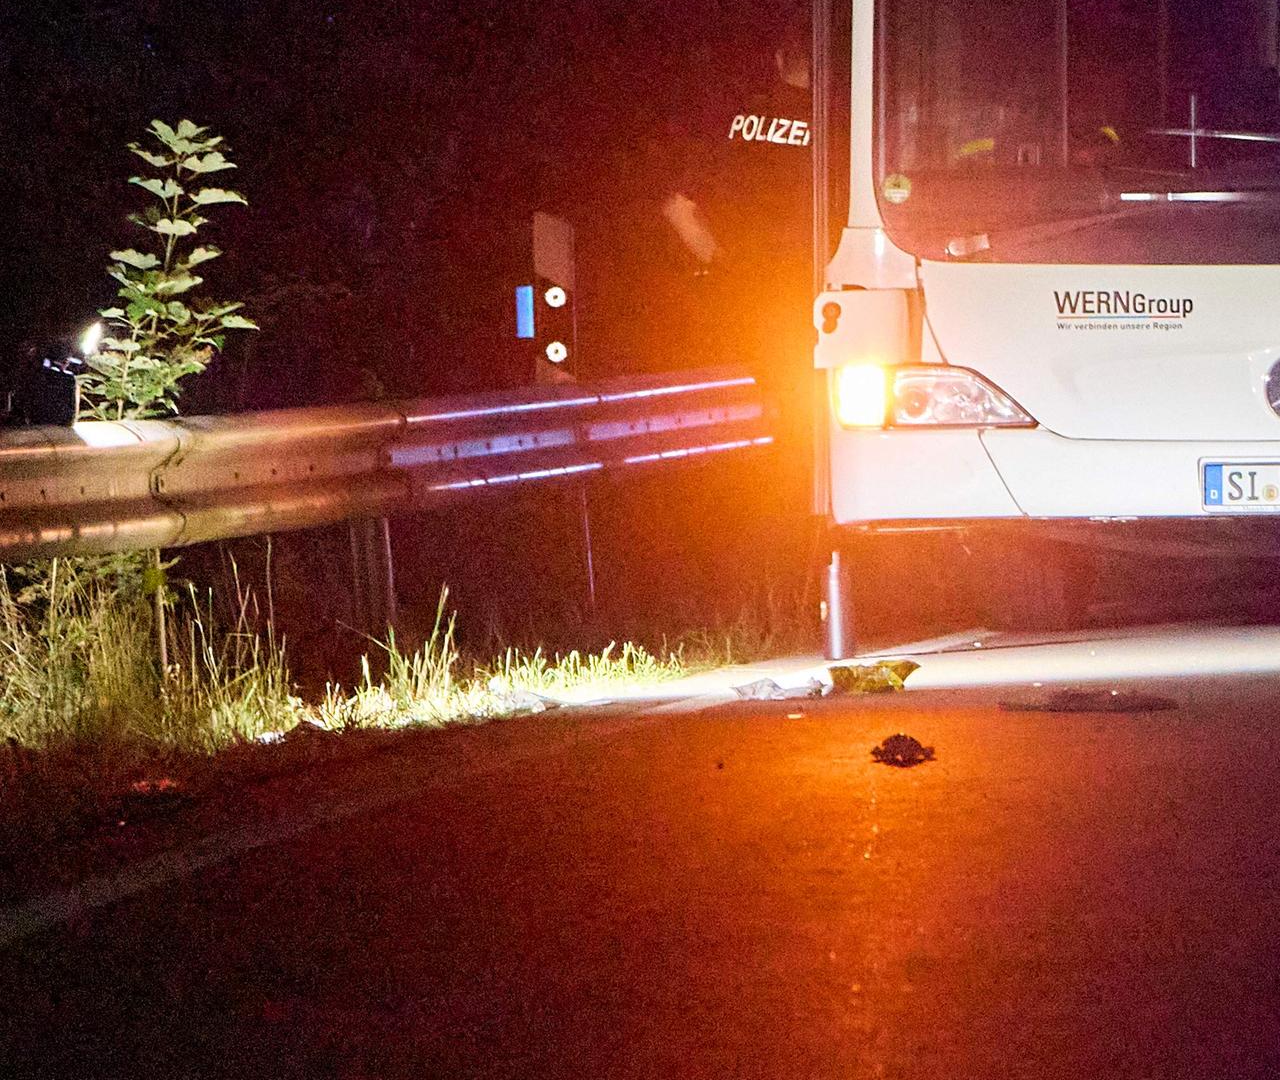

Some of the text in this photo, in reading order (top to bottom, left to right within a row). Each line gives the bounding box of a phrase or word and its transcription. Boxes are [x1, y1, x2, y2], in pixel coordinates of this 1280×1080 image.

[1054, 291, 1194, 318] WERNGroup
[1074, 322, 1119, 330] verbinden
[1152, 322, 1183, 332] Region
[1228, 472, 1259, 501] SI
